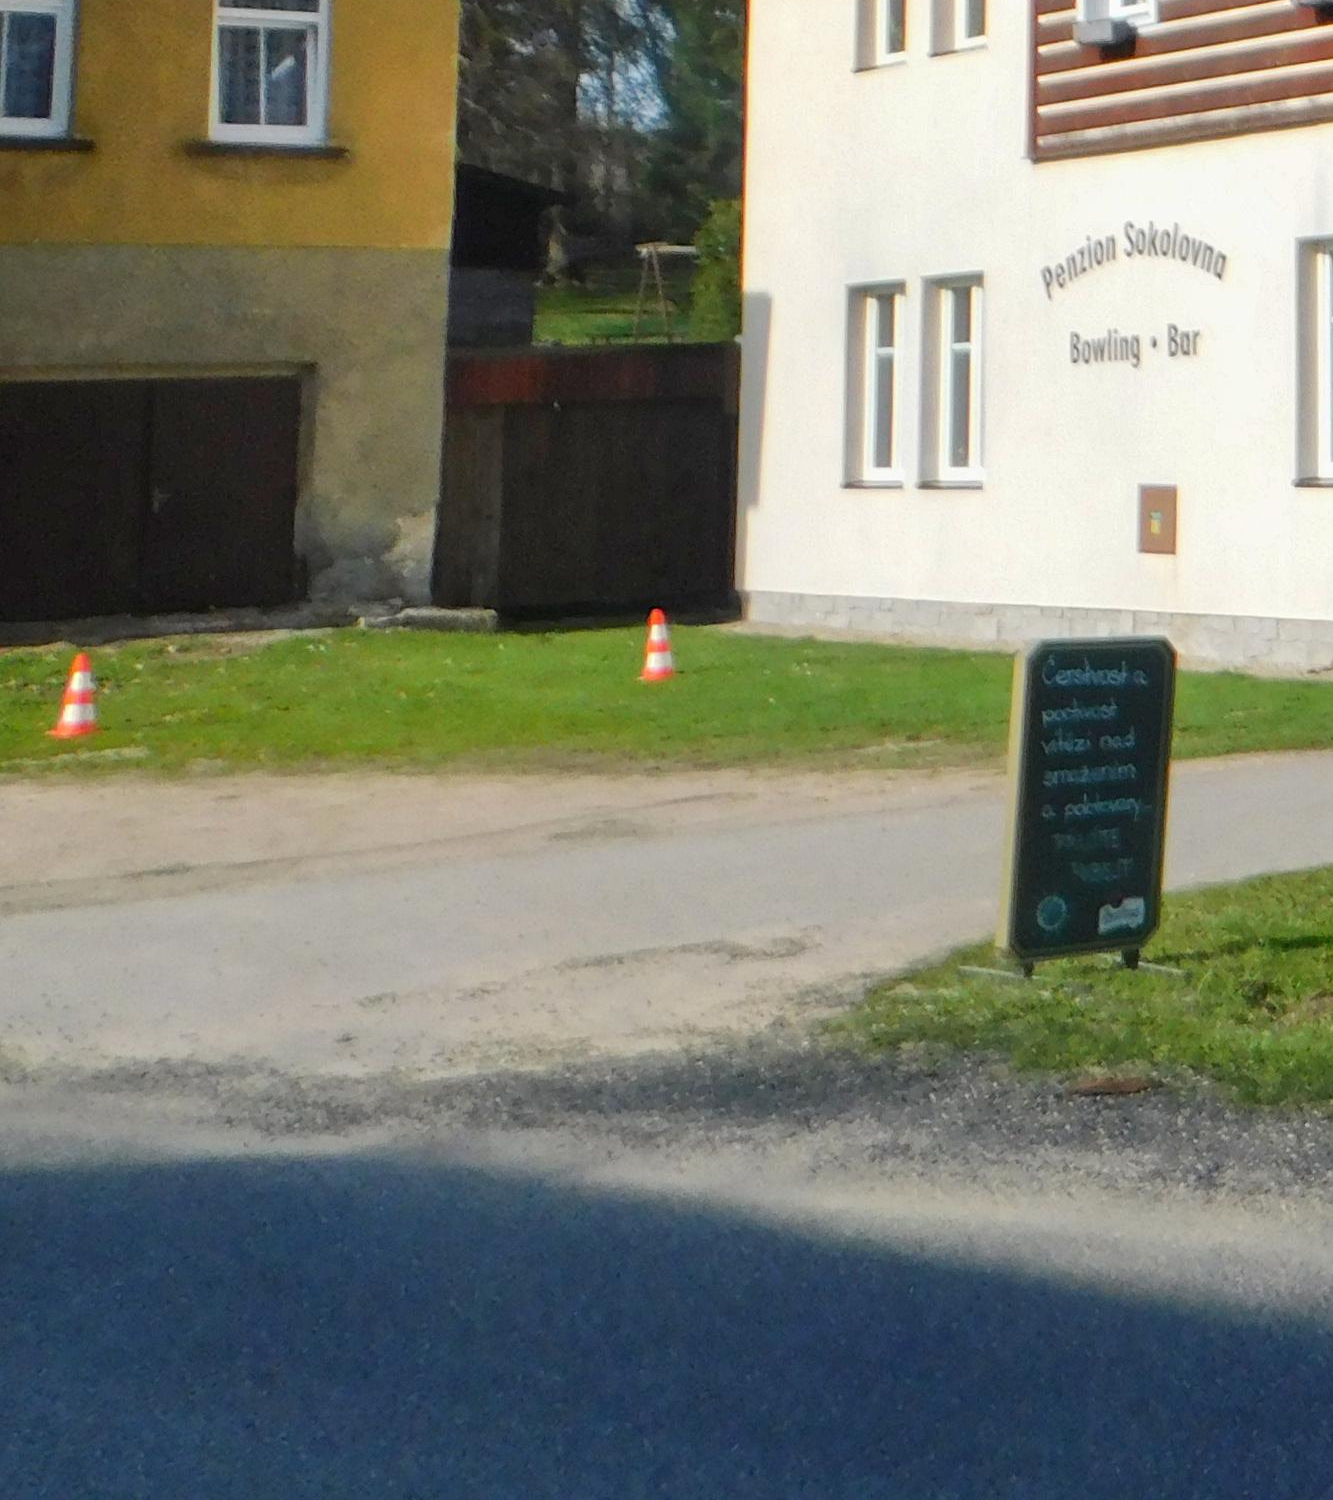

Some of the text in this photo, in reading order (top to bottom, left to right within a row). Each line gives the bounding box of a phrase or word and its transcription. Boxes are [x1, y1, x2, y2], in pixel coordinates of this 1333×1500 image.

[1040, 220, 1227, 300] Penzion Sokolovna
[1069, 323, 1200, 368] Bowling Bar
